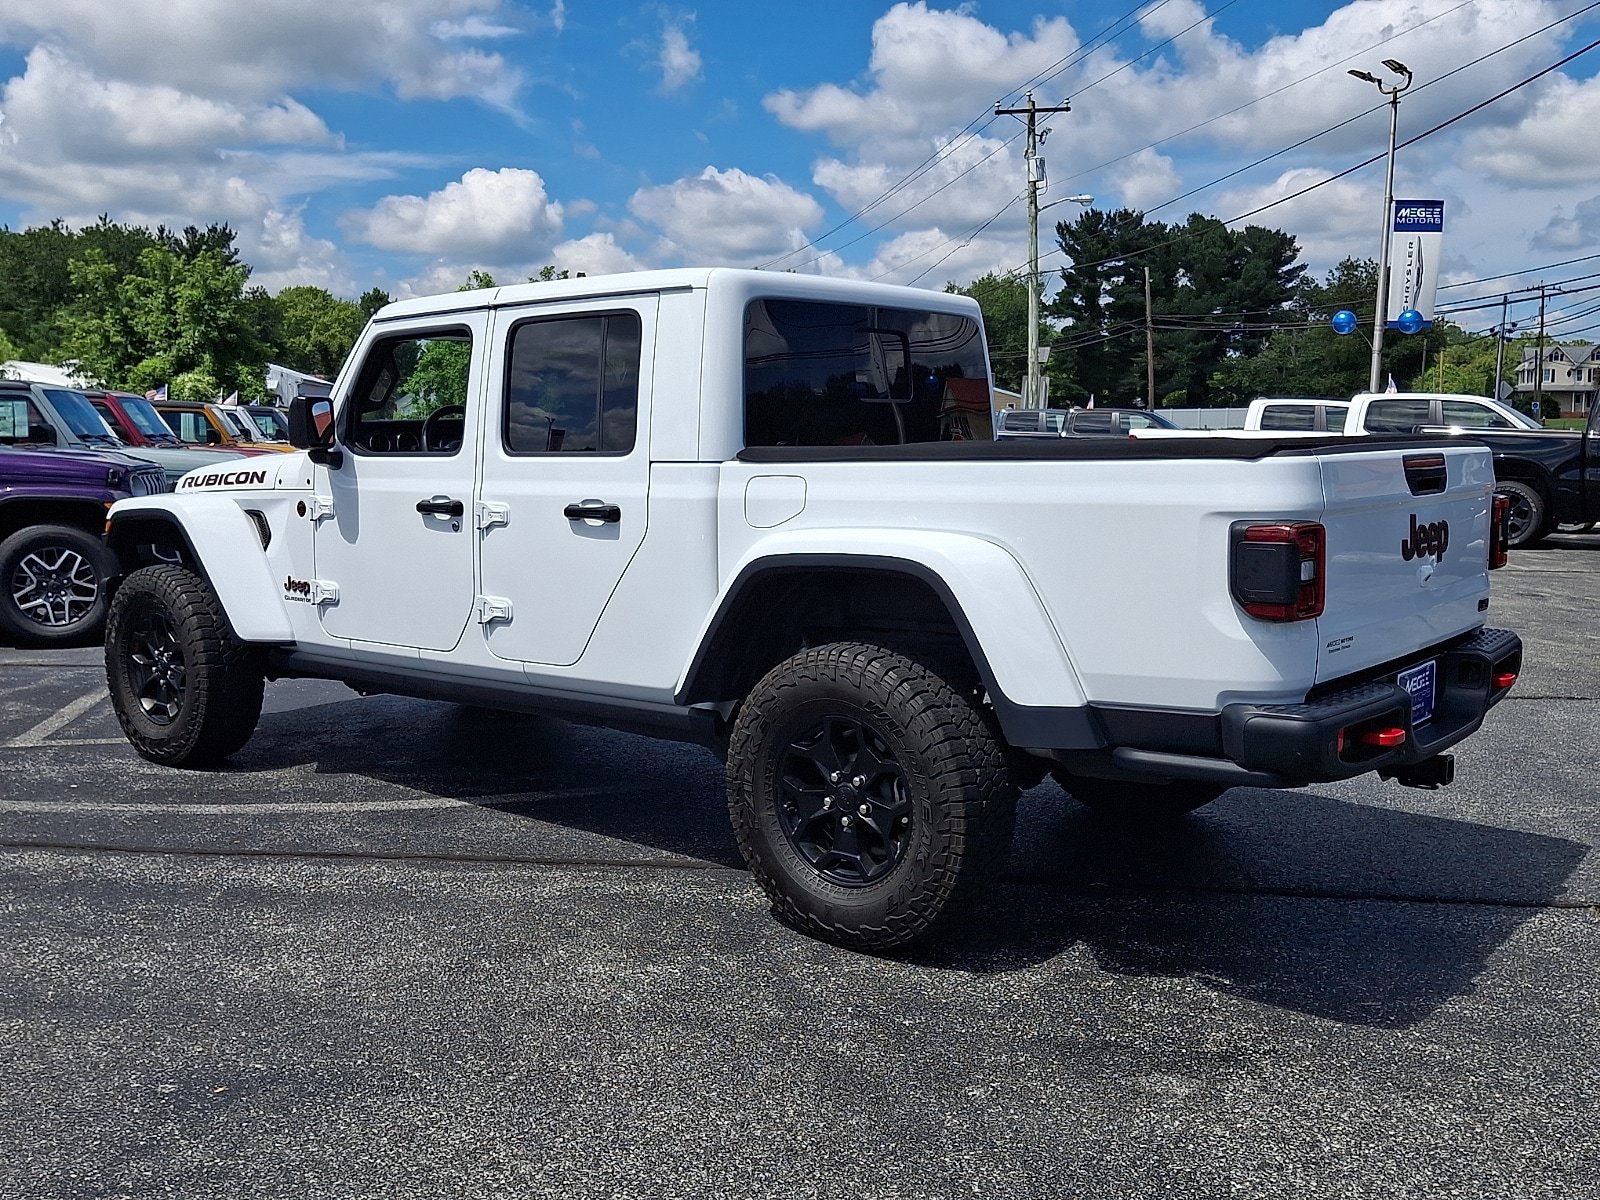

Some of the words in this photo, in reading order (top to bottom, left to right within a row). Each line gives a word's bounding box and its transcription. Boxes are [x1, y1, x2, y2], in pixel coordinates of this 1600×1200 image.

[1397, 207, 1441, 217] MEGEE
[1402, 241, 1414, 312] CHRYSLER
[181, 470, 267, 489] RUBICON
[1401, 513, 1449, 562] Jeep
[283, 575, 311, 597] Jeep
